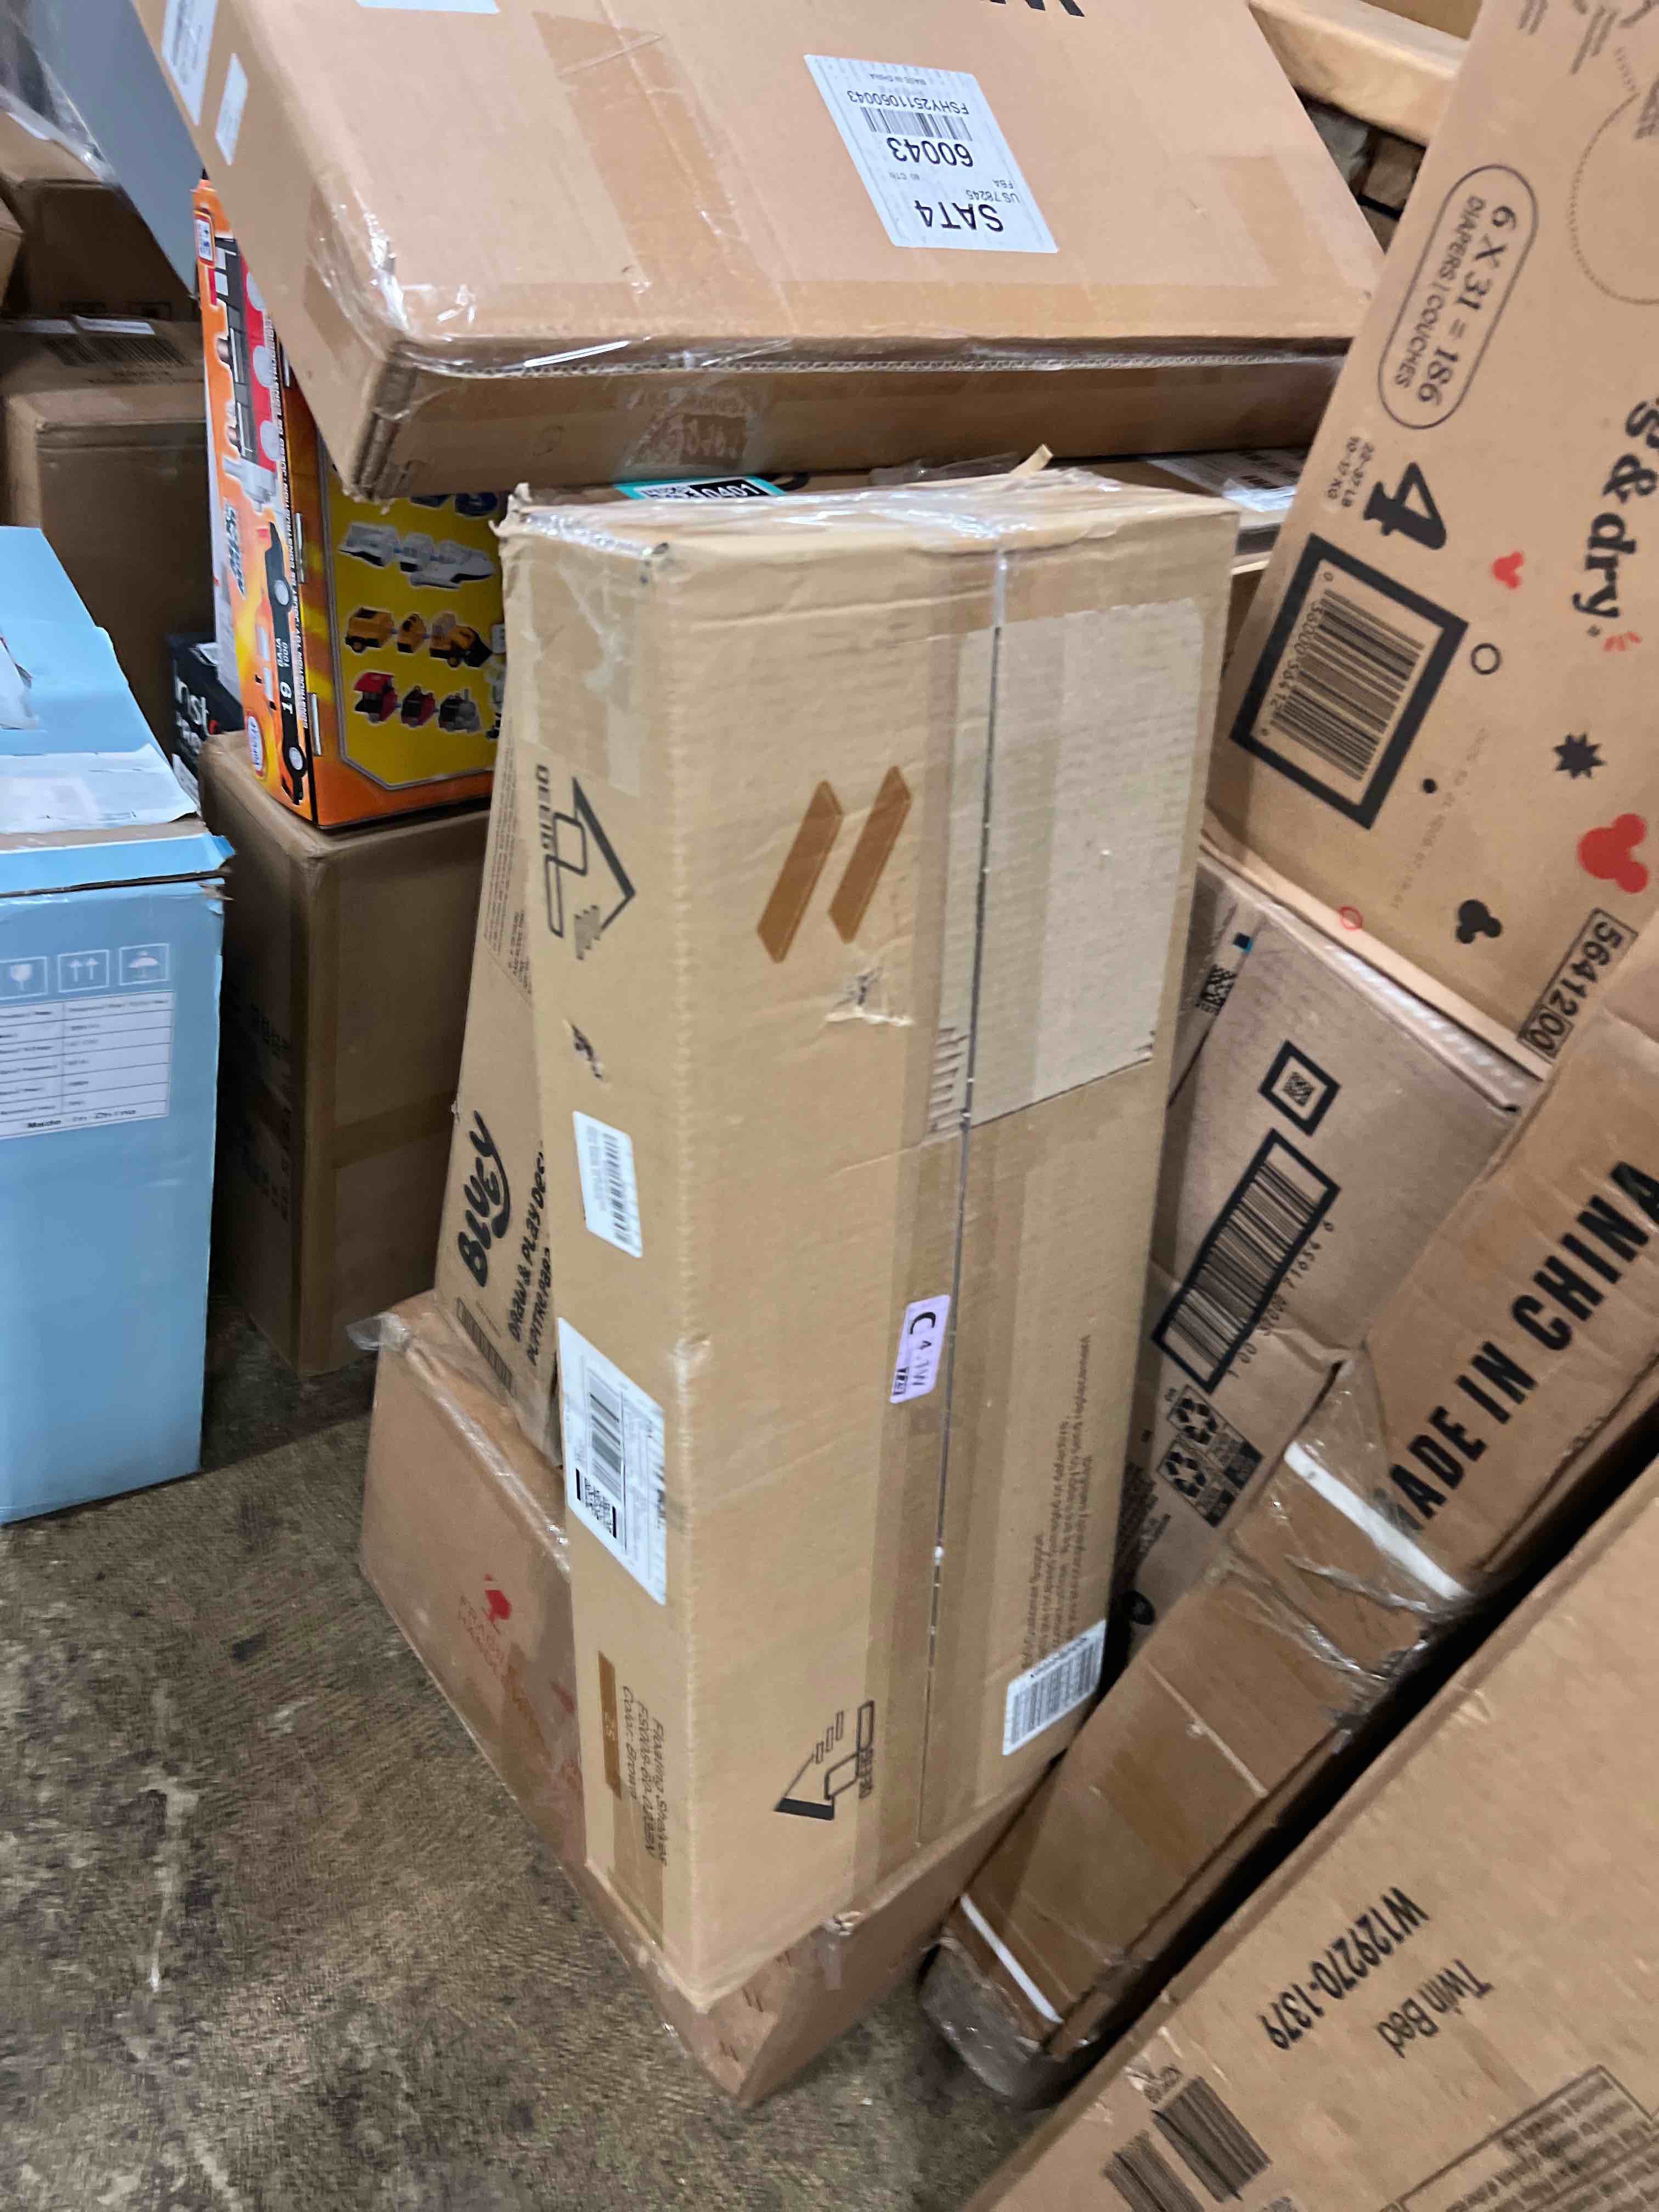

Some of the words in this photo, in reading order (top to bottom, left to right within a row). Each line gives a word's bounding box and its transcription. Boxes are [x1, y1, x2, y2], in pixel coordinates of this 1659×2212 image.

[886, 137, 974, 167] 60043
[914, 200, 1004, 232] SAT4
[966, 189, 1001, 202] 78245
[1000, 193, 1020, 204] US
[1491, 205, 1517, 230] 6
[1438, 195, 1486, 281] DIAPERS
[1457, 273, 1493, 311] 31
[1395, 292, 1444, 388] COUCHES
[1417, 346, 1459, 407] 186
[1362, 462, 1447, 550] 4
[1602, 453, 1657, 504] &
[1571, 512, 1637, 618] dry
[1455, 1340, 1538, 1425] IN
[1511, 1160, 1659, 1351] CHINA
[1256, 1886, 1430, 2050] W129270-1379
[1416, 1958, 1492, 2015] Twin
[1375, 1997, 1439, 2059] Bed
